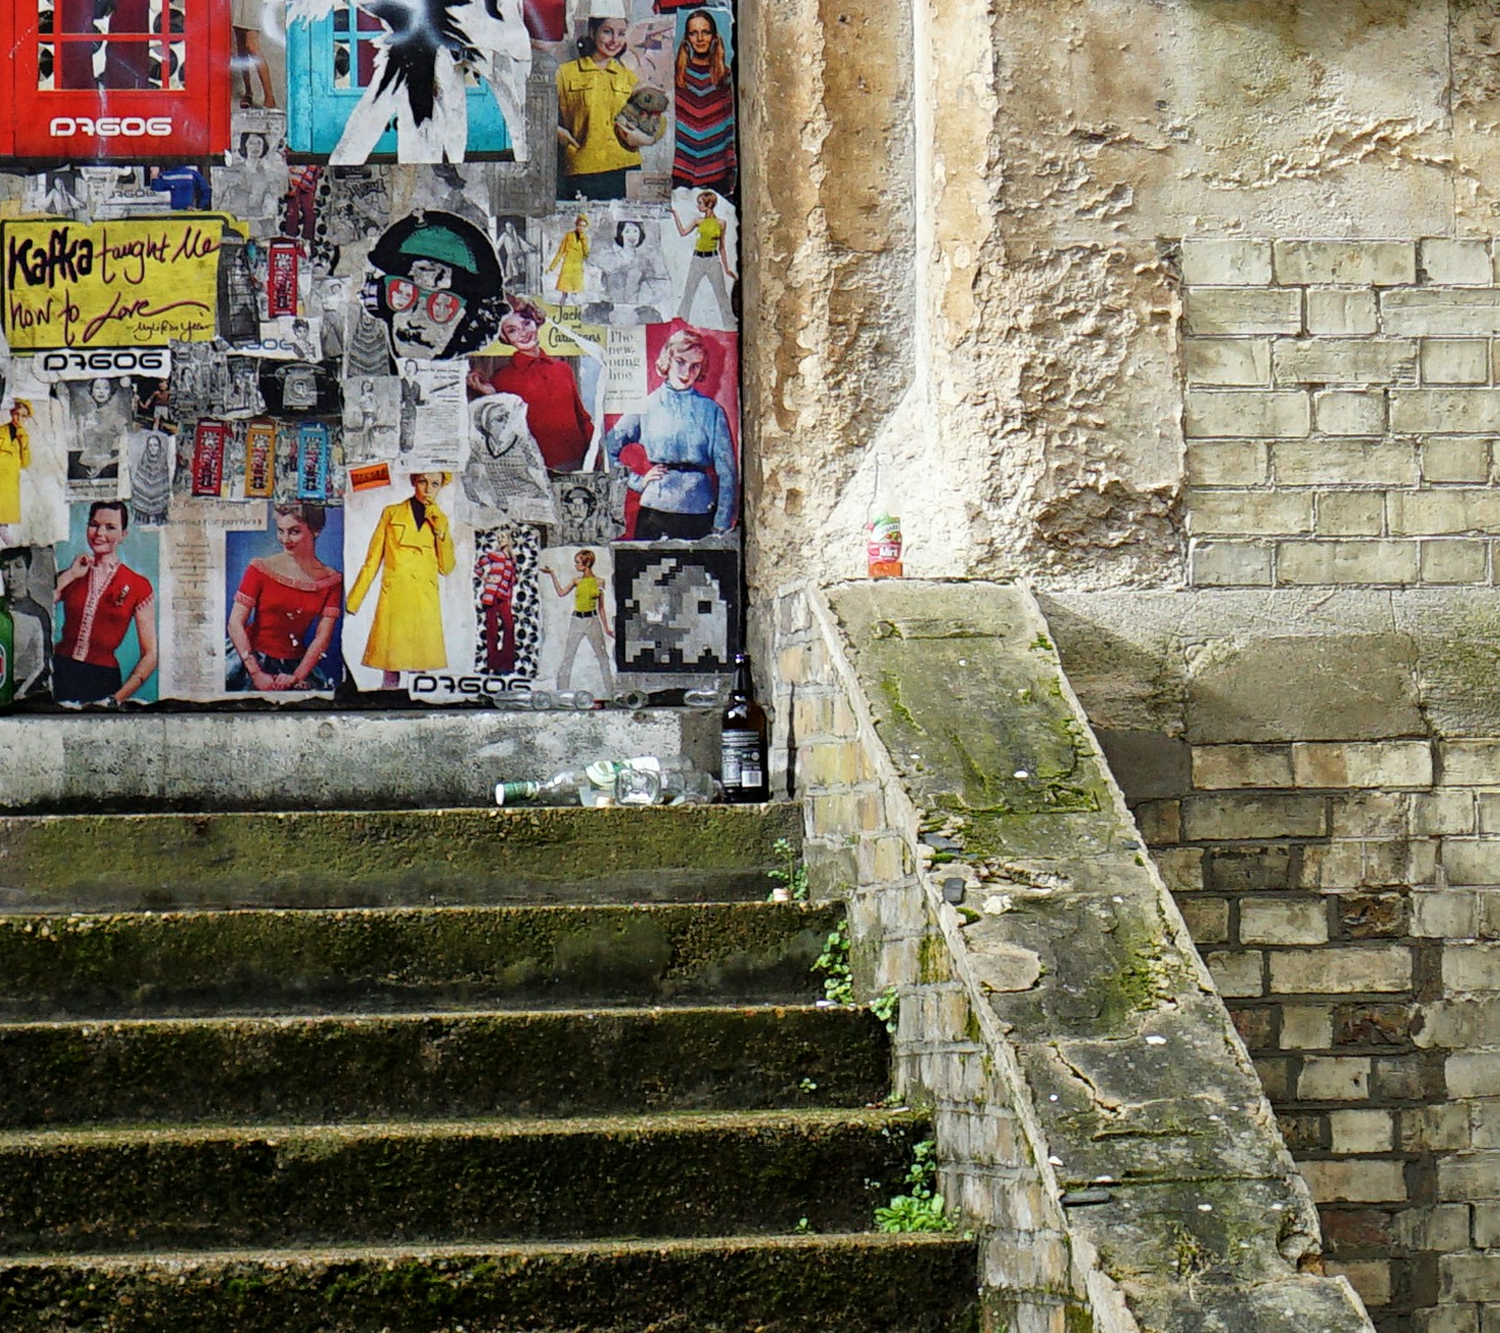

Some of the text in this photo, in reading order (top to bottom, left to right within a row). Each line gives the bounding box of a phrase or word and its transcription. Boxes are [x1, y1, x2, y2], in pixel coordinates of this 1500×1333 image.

[49, 116, 173, 137] D7606
[6, 225, 223, 291] Kafka taught Me
[56, 287, 81, 347] to
[81, 290, 192, 344] Love
[610, 330, 634, 343] The
[43, 352, 164, 372] D7606
[413, 675, 532, 694] D7606
